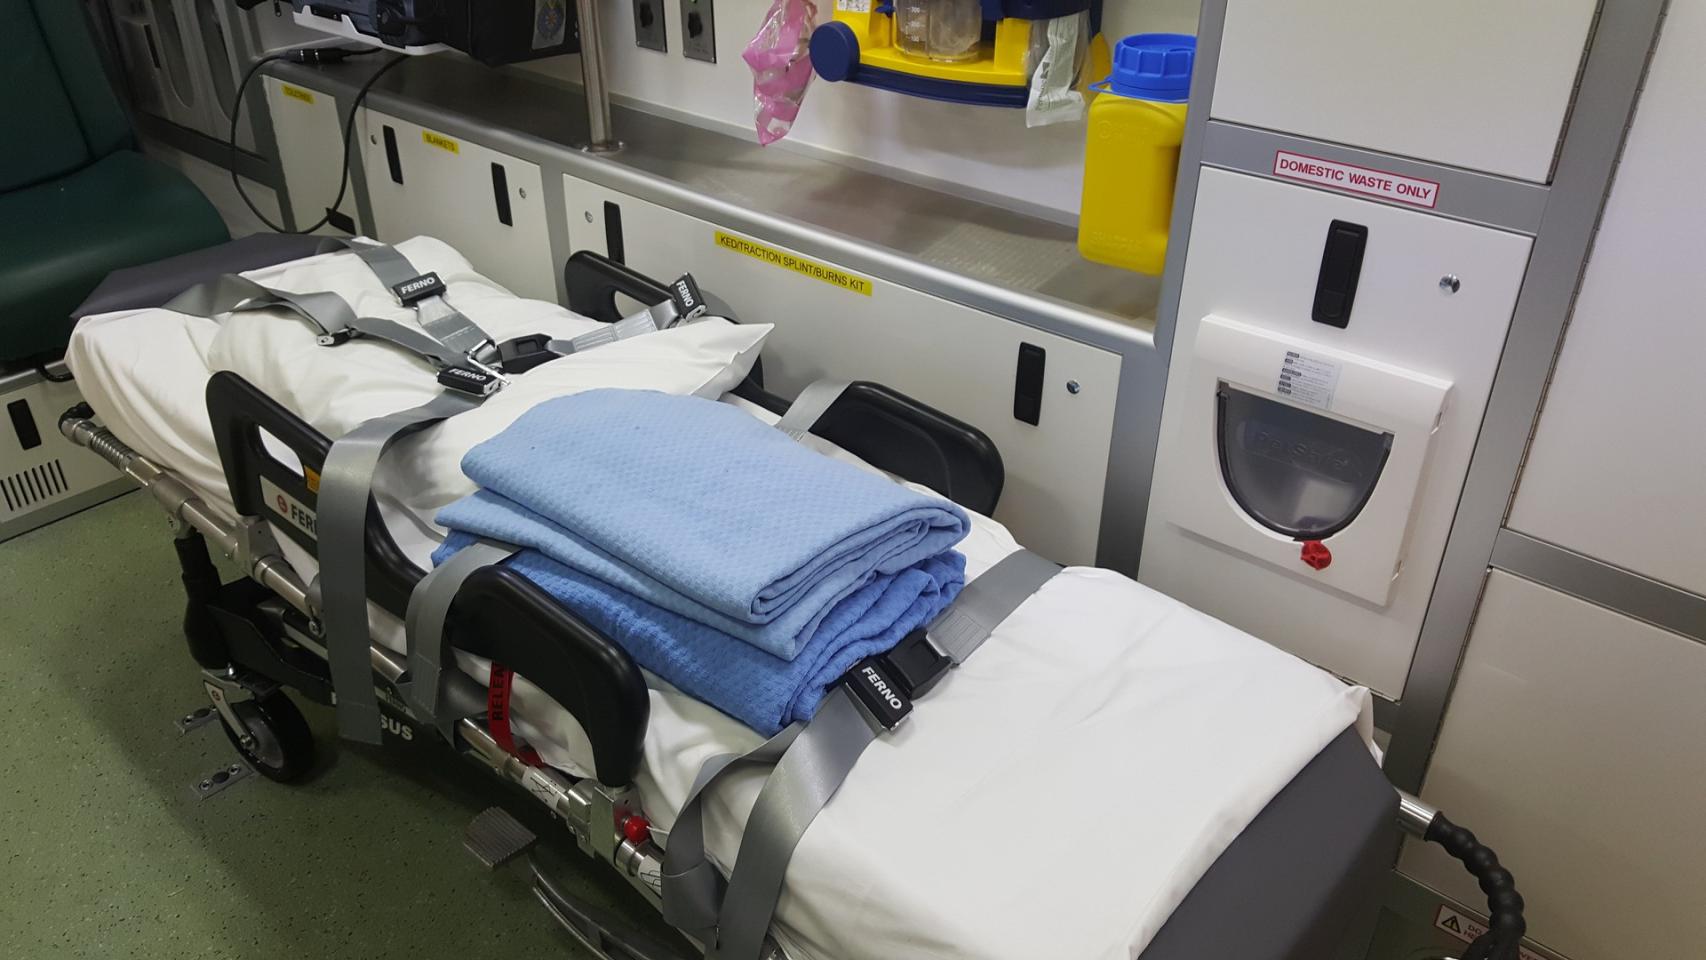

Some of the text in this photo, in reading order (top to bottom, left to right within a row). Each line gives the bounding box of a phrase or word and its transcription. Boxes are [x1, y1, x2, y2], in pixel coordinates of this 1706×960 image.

[425, 132, 456, 152] BLANKETS
[1279, 158, 1432, 200] DOMESTIC WASTE ONLY
[719, 235, 865, 292] KED/TRACTION SPLINT/BURNS KIT
[400, 276, 436, 295] FERNO
[675, 279, 694, 308] FERNO
[447, 367, 487, 381] FERNO
[290, 503, 318, 536] FER
[861, 665, 903, 710] FERNO
[380, 713, 414, 741] SUS
